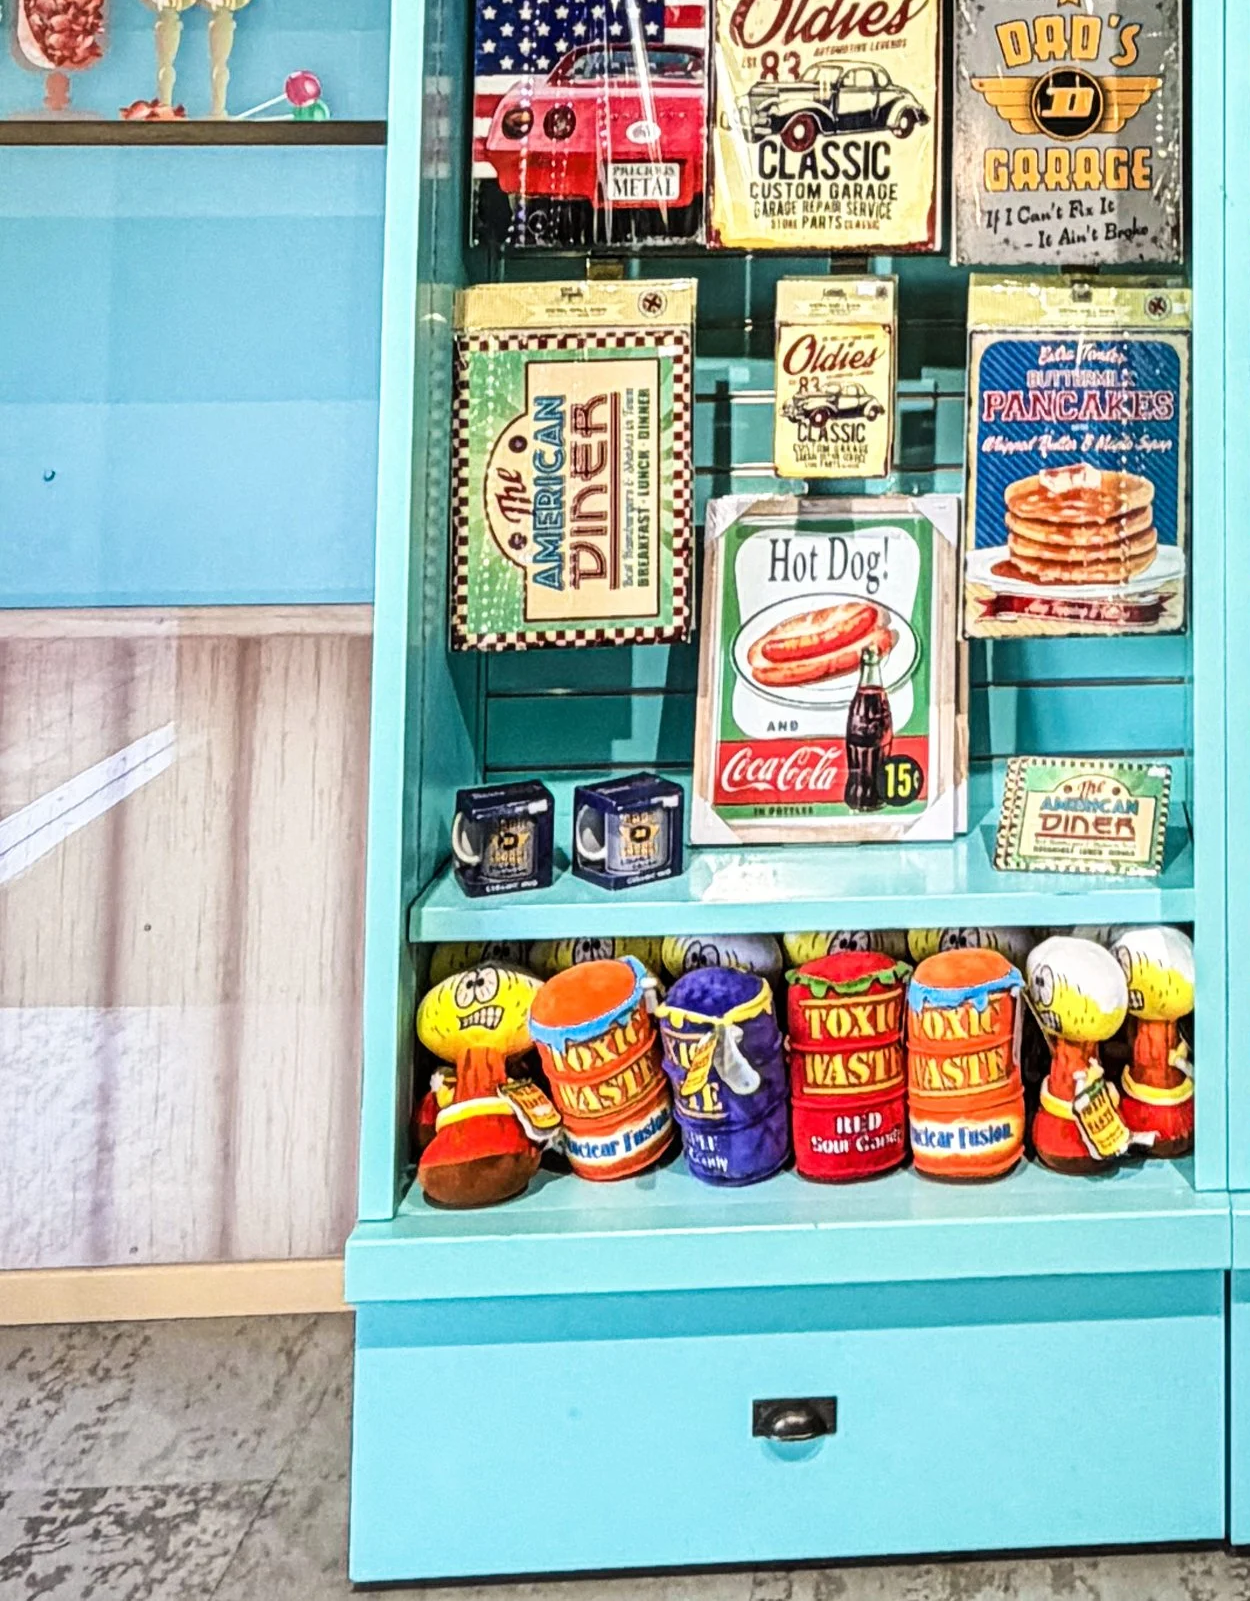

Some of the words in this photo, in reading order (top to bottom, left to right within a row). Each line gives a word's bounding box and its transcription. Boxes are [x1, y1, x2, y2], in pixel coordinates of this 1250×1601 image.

[994, 13, 1143, 68] DAD'S
[760, 50, 801, 82] 83
[758, 139, 892, 181] CLASSIC
[983, 146, 1153, 192] GARAGE
[750, 181, 821, 200] CUSTOM
[829, 182, 899, 201] GARAGE
[753, 200, 798, 219] GARAGE
[802, 200, 842, 214] REPAIR
[846, 200, 893, 221] SERVICE
[801, 214, 843, 230] PARTS
[985, 210, 1001, 230] If
[1017, 202, 1063, 224] Can't
[1068, 199, 1094, 219] Fix
[1099, 196, 1116, 215] It
[1059, 225, 1099, 247] Ain't
[1103, 217, 1149, 240] Broke
[783, 333, 886, 376] Oldies
[638, 388, 650, 440] DINNER
[982, 390, 1175, 422] PANCAKES
[797, 422, 866, 443] CLASSIC
[638, 450, 650, 497] LUNCH
[494, 466, 532, 524] The
[532, 394, 567, 591] AMERICAN
[638, 508, 650, 588] BREAKFAST
[768, 536, 819, 583] Hot
[826, 535, 891, 595] Dog!
[766, 720, 799, 733] AND
[720, 745, 844, 793] Coca-Cola
[1077, 779, 1107, 799] The
[1040, 796, 1140, 816] AMERICAN
[836, 1111, 883, 1135] RED
[810, 1135, 849, 1155] Sour
